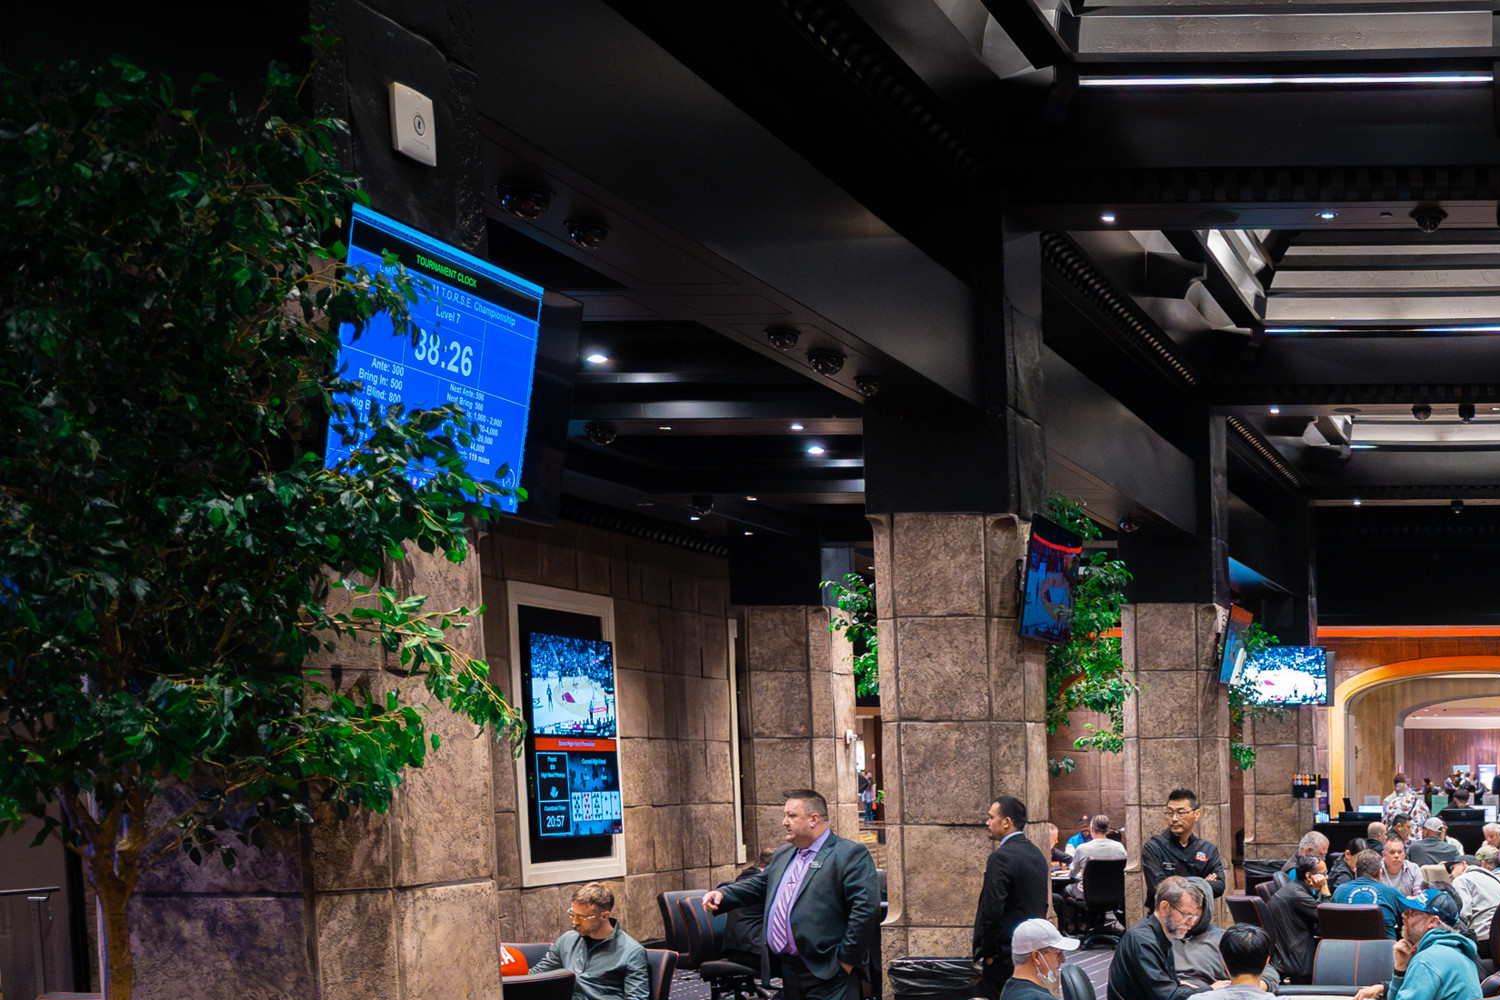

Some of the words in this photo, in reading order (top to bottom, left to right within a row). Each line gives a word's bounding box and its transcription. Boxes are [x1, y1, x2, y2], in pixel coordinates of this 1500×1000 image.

[417, 254, 457, 279] TOURNAMENT
[457, 273, 477, 288] CLOCK
[436, 306, 456, 322] Level
[456, 313, 461, 324] 7
[474, 301, 516, 327] Championship
[414, 328, 473, 377] 38:26
[371, 357, 390, 372] Ante:
[391, 364, 404, 377] 300
[358, 367, 378, 385] Bring
[379, 374, 388, 386] In:
[390, 378, 403, 390] 500
[366, 385, 386, 400] Blind:
[388, 392, 401, 403] 800
[449, 383, 462, 394] Next
[475, 391, 485, 401] 500
[446, 393, 459, 403] Next
[474, 402, 484, 411] 500
[546, 815, 565, 828] 20:57
